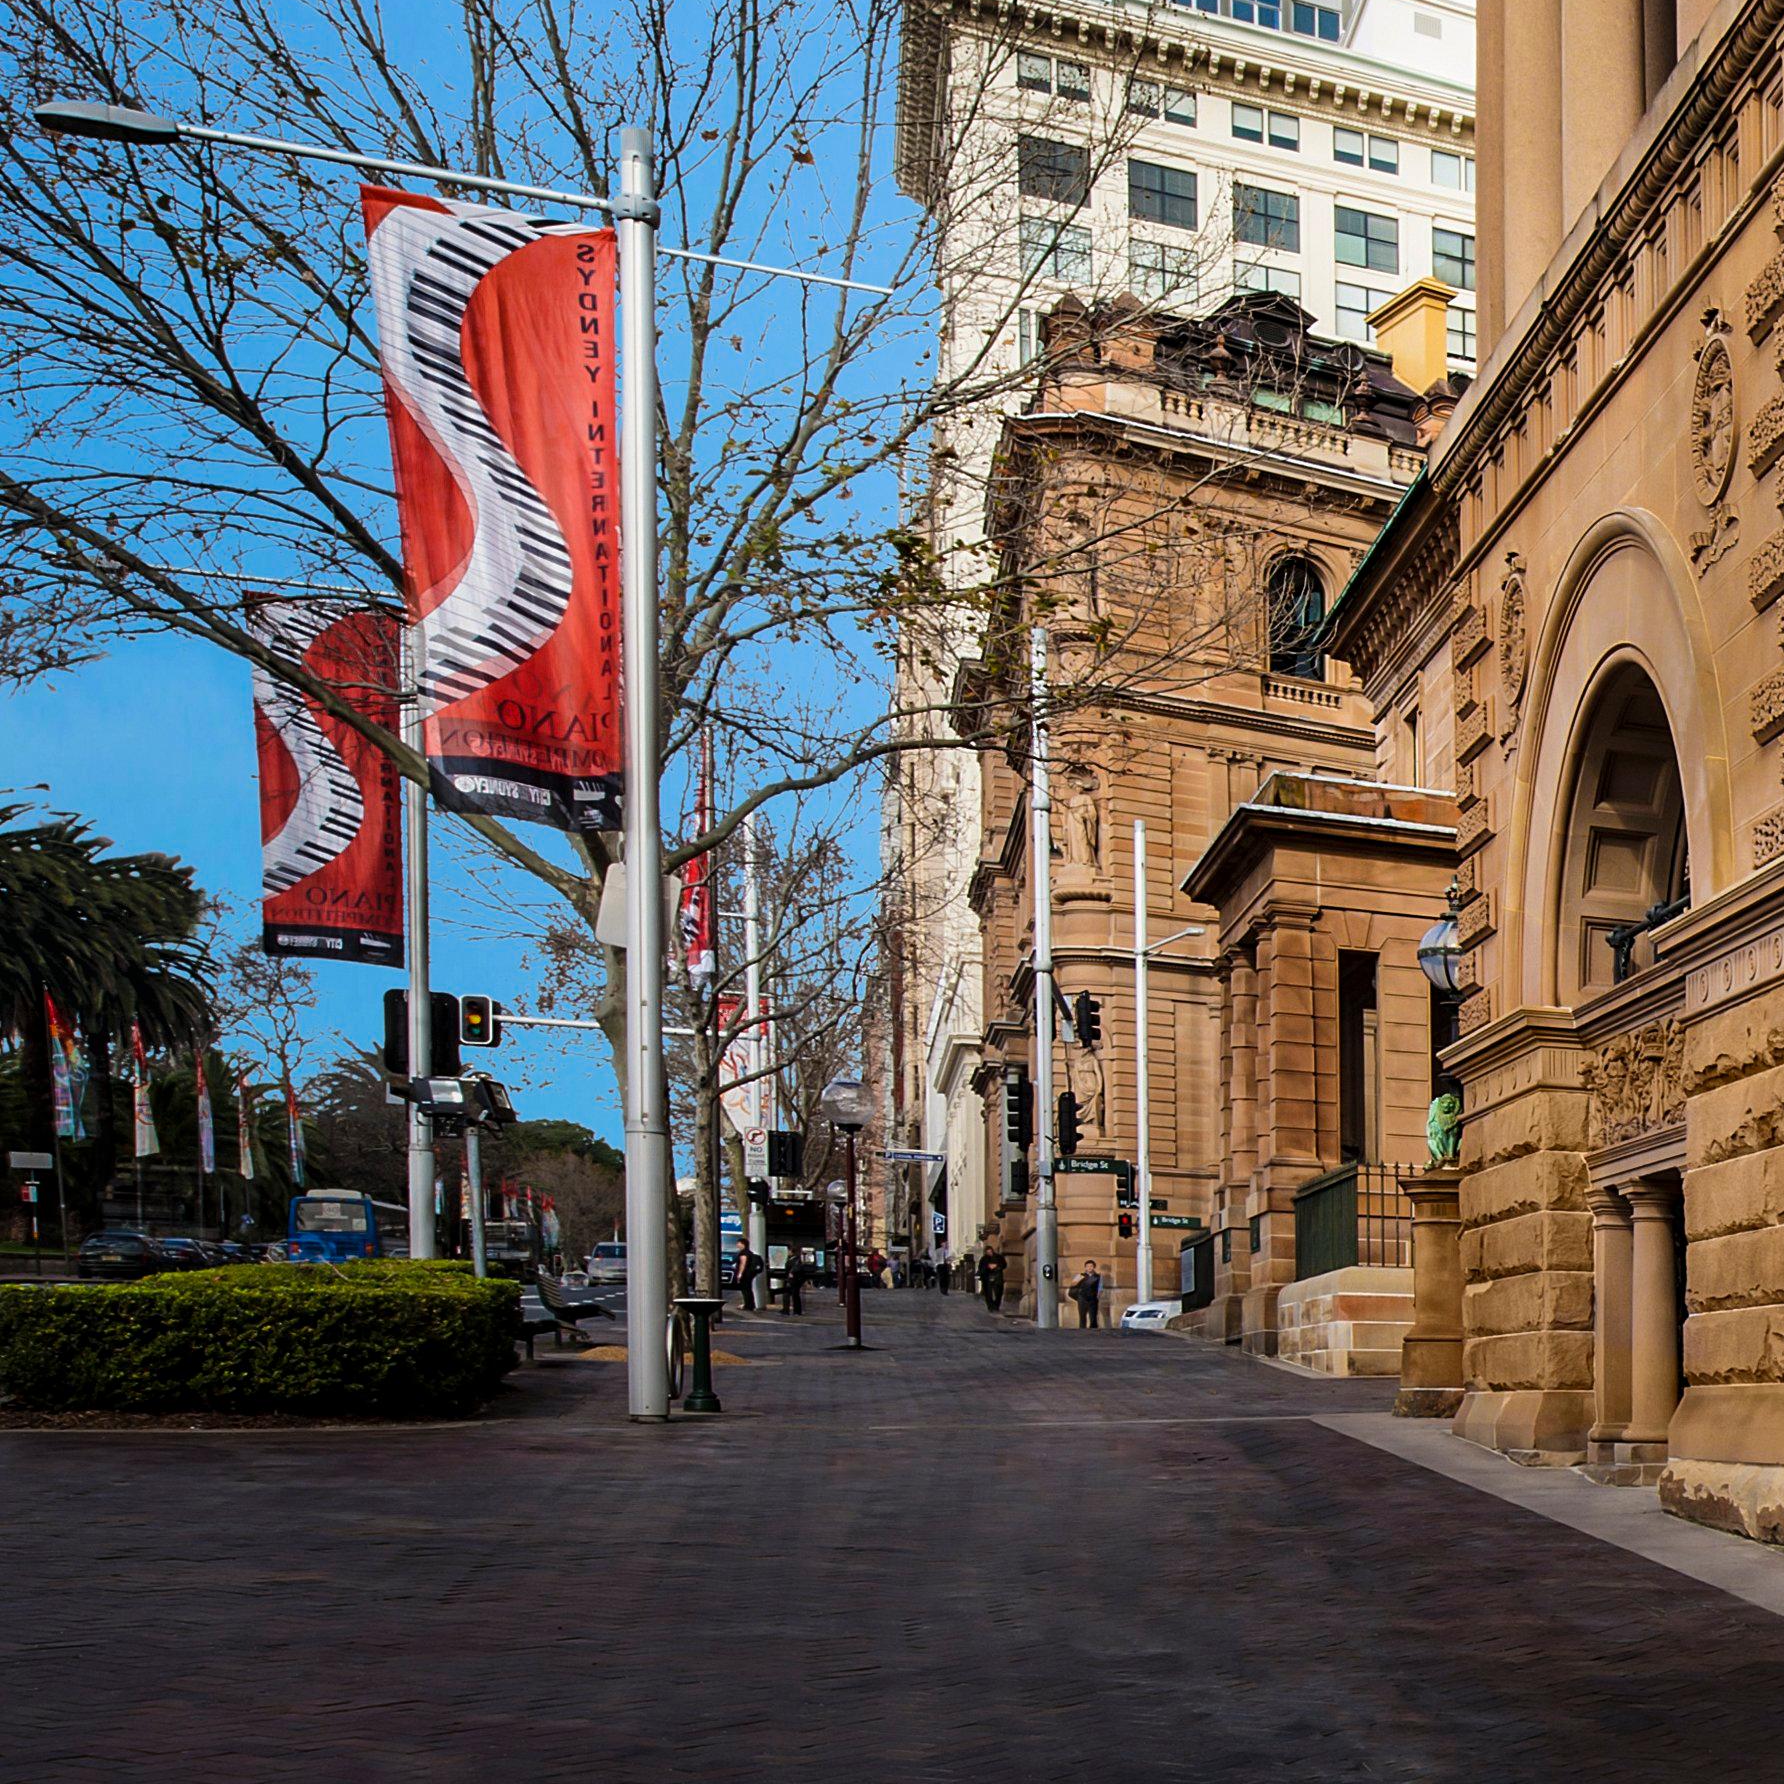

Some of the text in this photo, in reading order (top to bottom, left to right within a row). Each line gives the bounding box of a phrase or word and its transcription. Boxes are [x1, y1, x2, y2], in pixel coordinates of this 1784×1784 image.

[1071, 1159, 1109, 1170] Bridge St
[1161, 1217, 1181, 1225] Bridge
